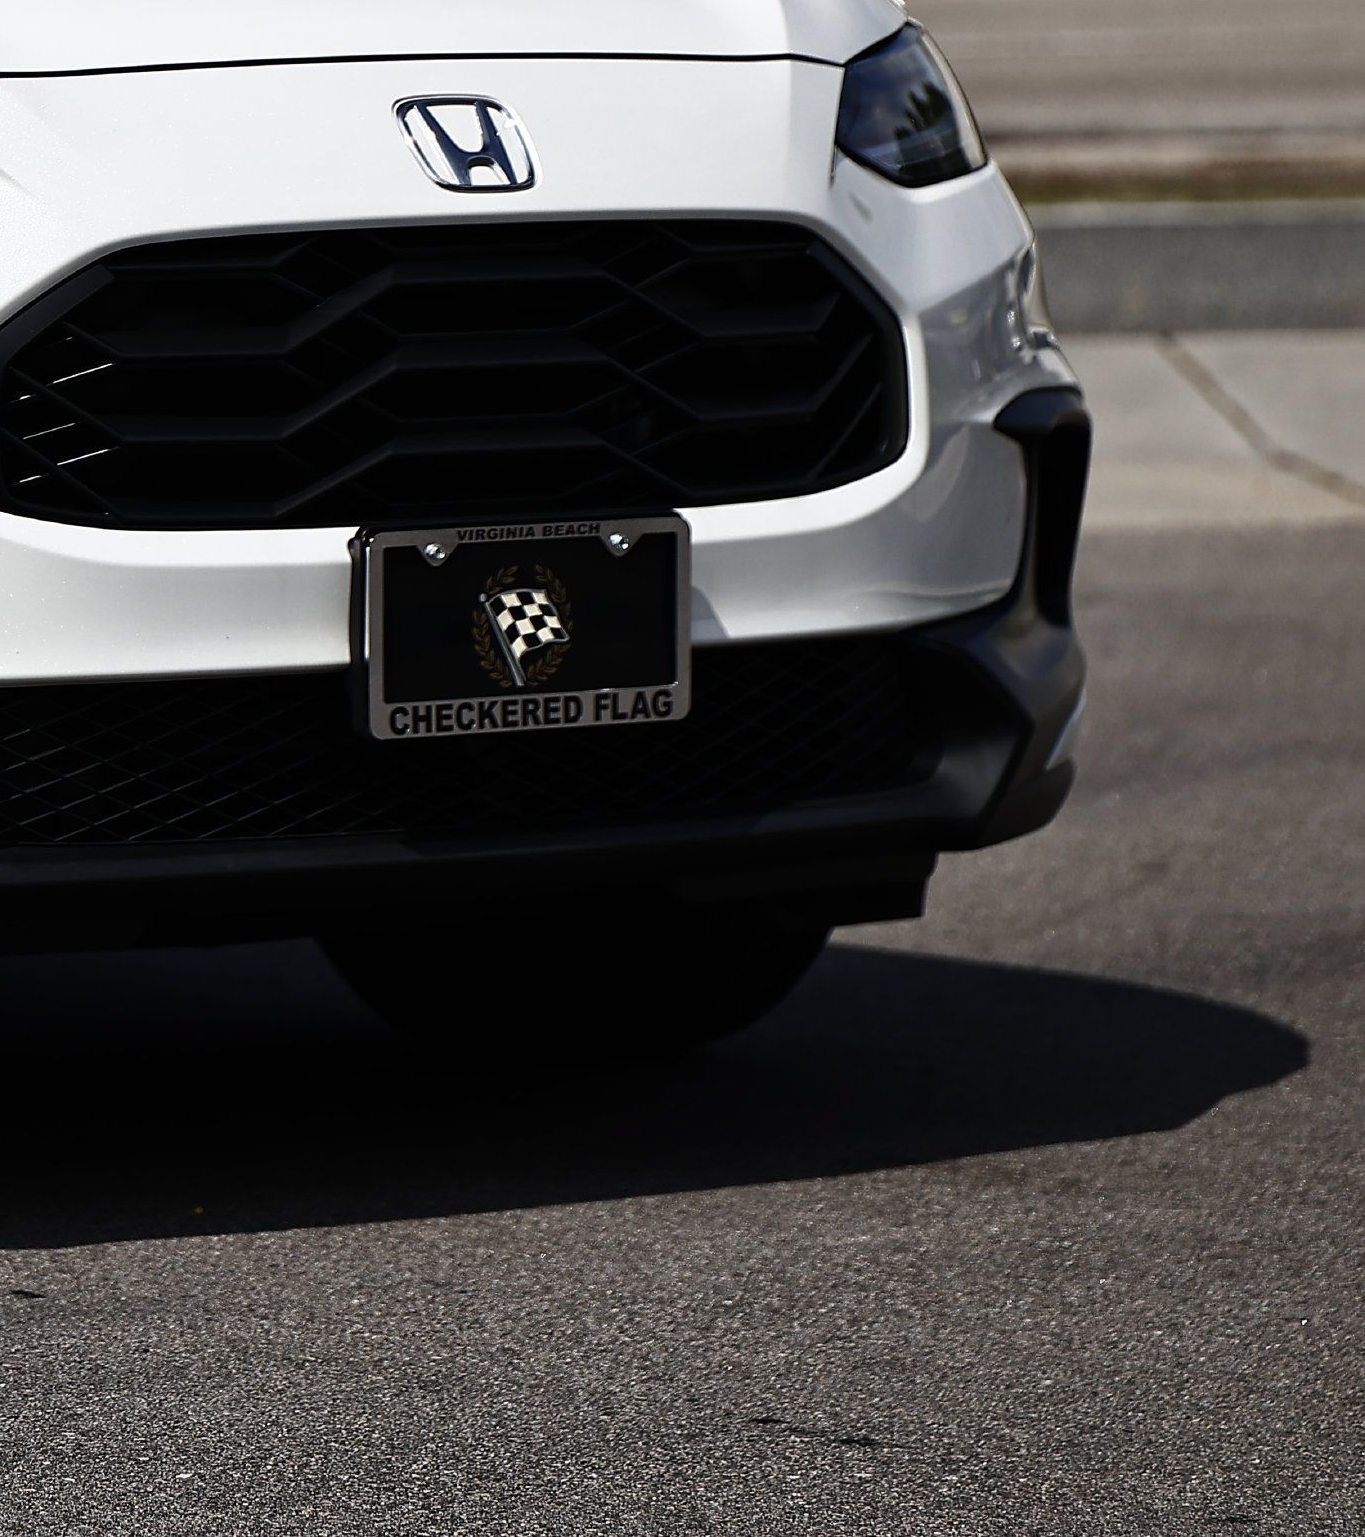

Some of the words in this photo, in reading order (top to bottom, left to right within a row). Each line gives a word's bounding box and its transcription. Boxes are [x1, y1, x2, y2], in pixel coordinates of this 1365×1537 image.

[456, 525, 536, 541] VIRGINIA
[541, 523, 601, 538] BEACH
[389, 694, 583, 736] CHECKERED
[594, 689, 674, 722] FLAG
